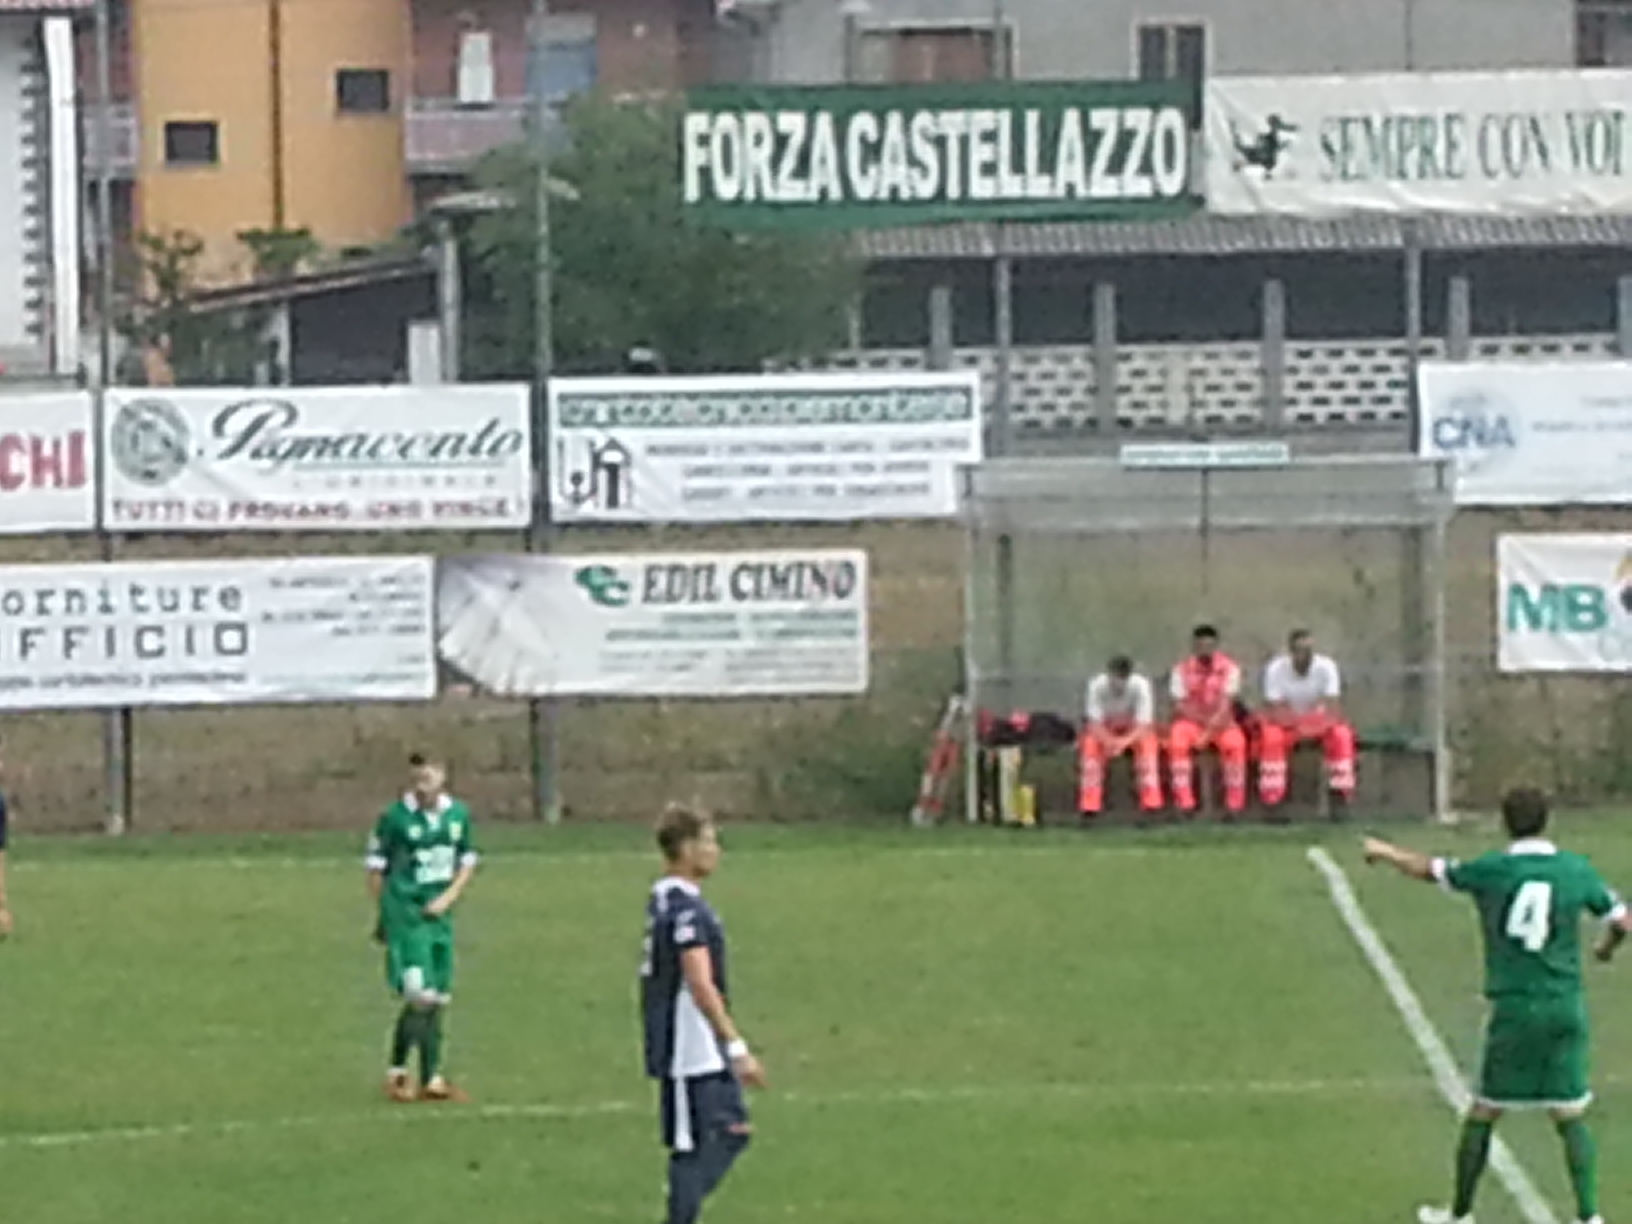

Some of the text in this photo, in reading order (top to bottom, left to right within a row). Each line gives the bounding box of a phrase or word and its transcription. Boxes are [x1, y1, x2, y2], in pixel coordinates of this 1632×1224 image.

[684, 106, 1187, 202] FORZA CASTELLAZZO
[1320, 112, 1466, 181] SEMPRE
[1478, 112, 1551, 180] CON
[1432, 415, 1516, 449] CNA
[641, 560, 858, 606] EDIL CIMINO
[1506, 582, 1609, 633] MB
[1506, 880, 1553, 952] 4
